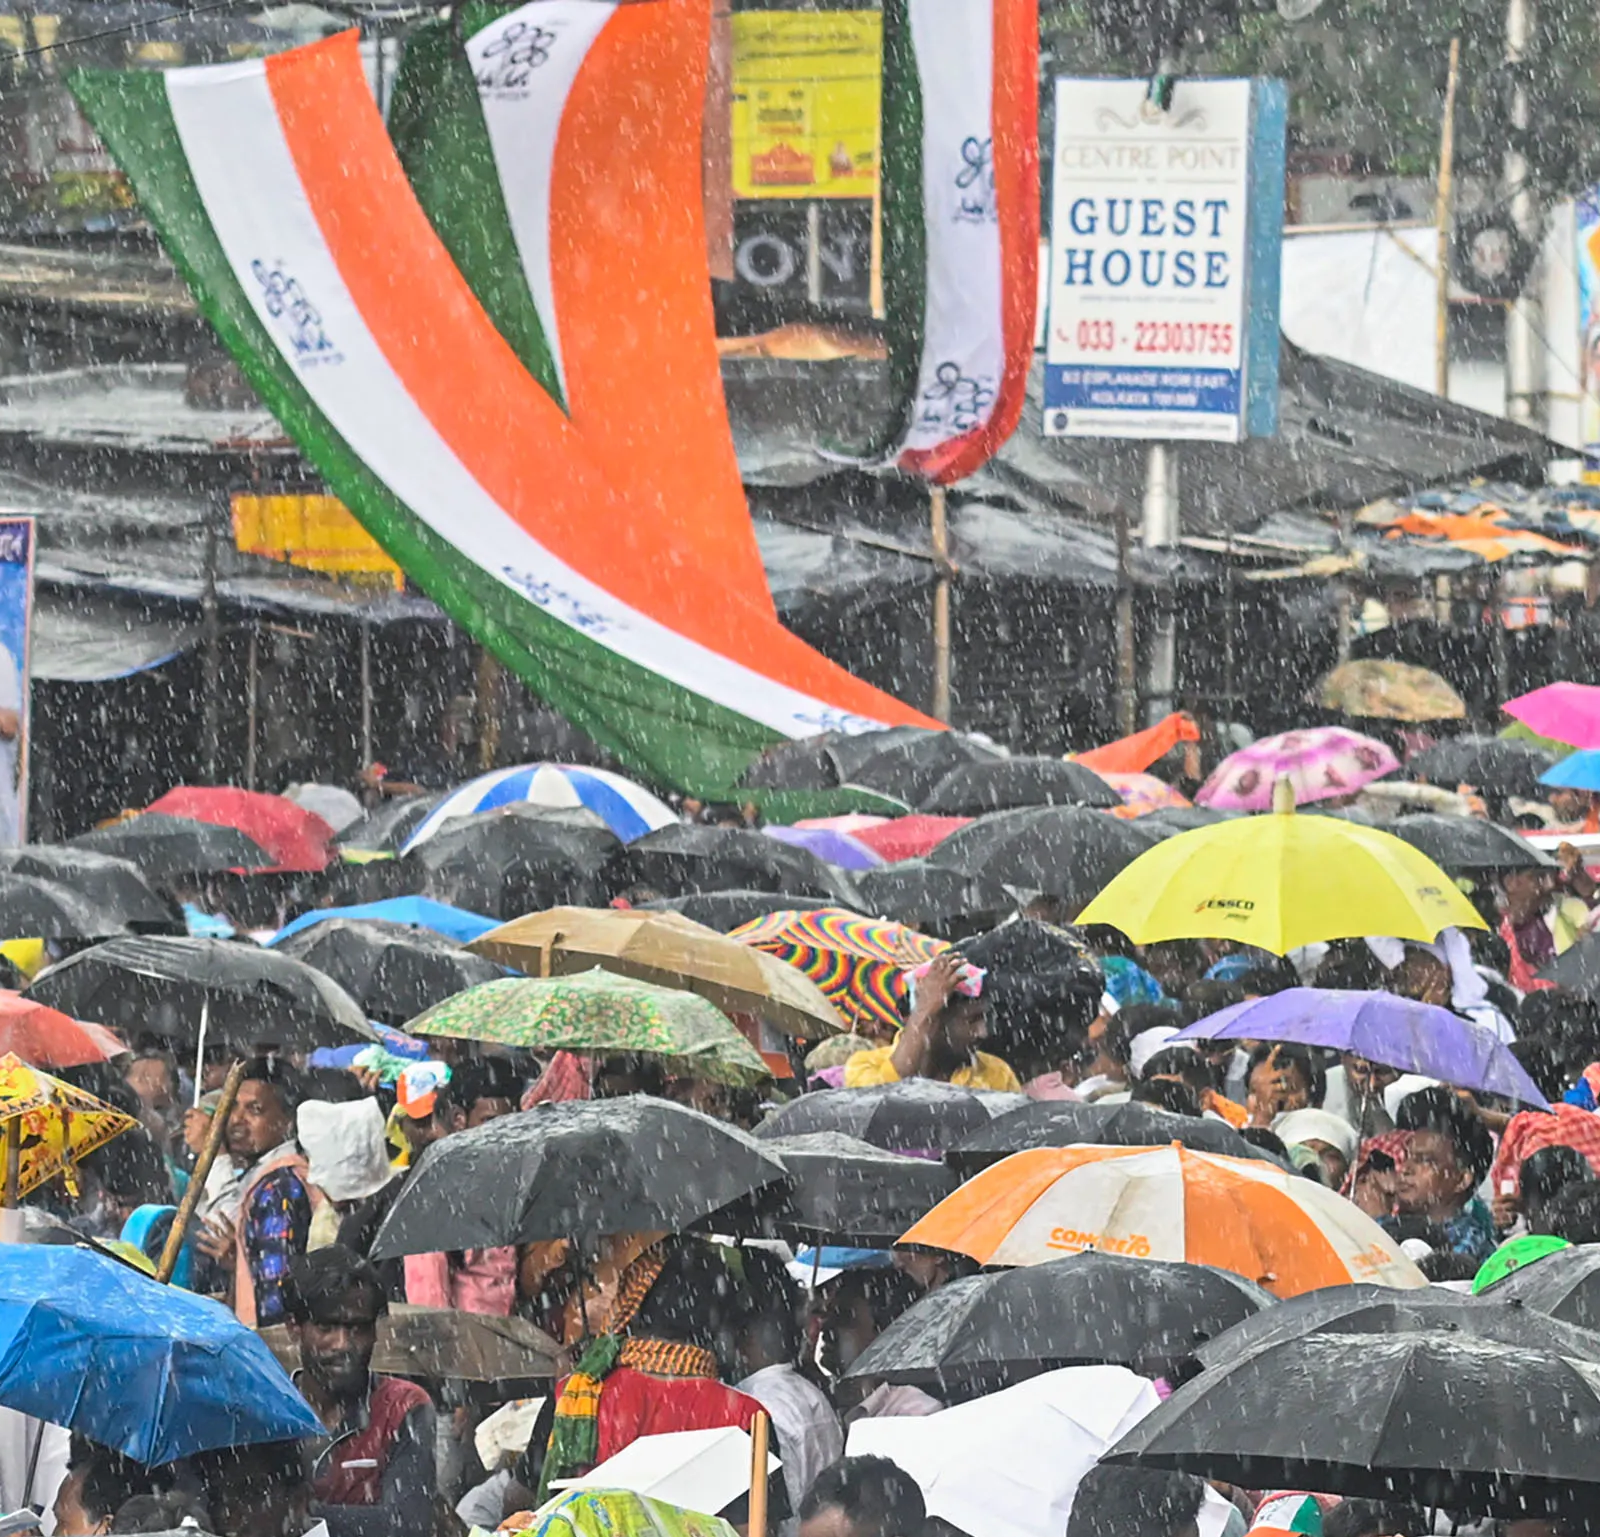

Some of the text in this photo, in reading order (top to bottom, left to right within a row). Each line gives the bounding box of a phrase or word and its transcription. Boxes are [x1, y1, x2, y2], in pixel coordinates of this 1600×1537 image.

[1062, 146, 1241, 170] CENTRE POINT
[1069, 198, 1229, 237] GUEST
[1064, 248, 1231, 288] HOUSE
[1077, 319, 1114, 351] 033
[1134, 321, 1233, 355] 22303755
